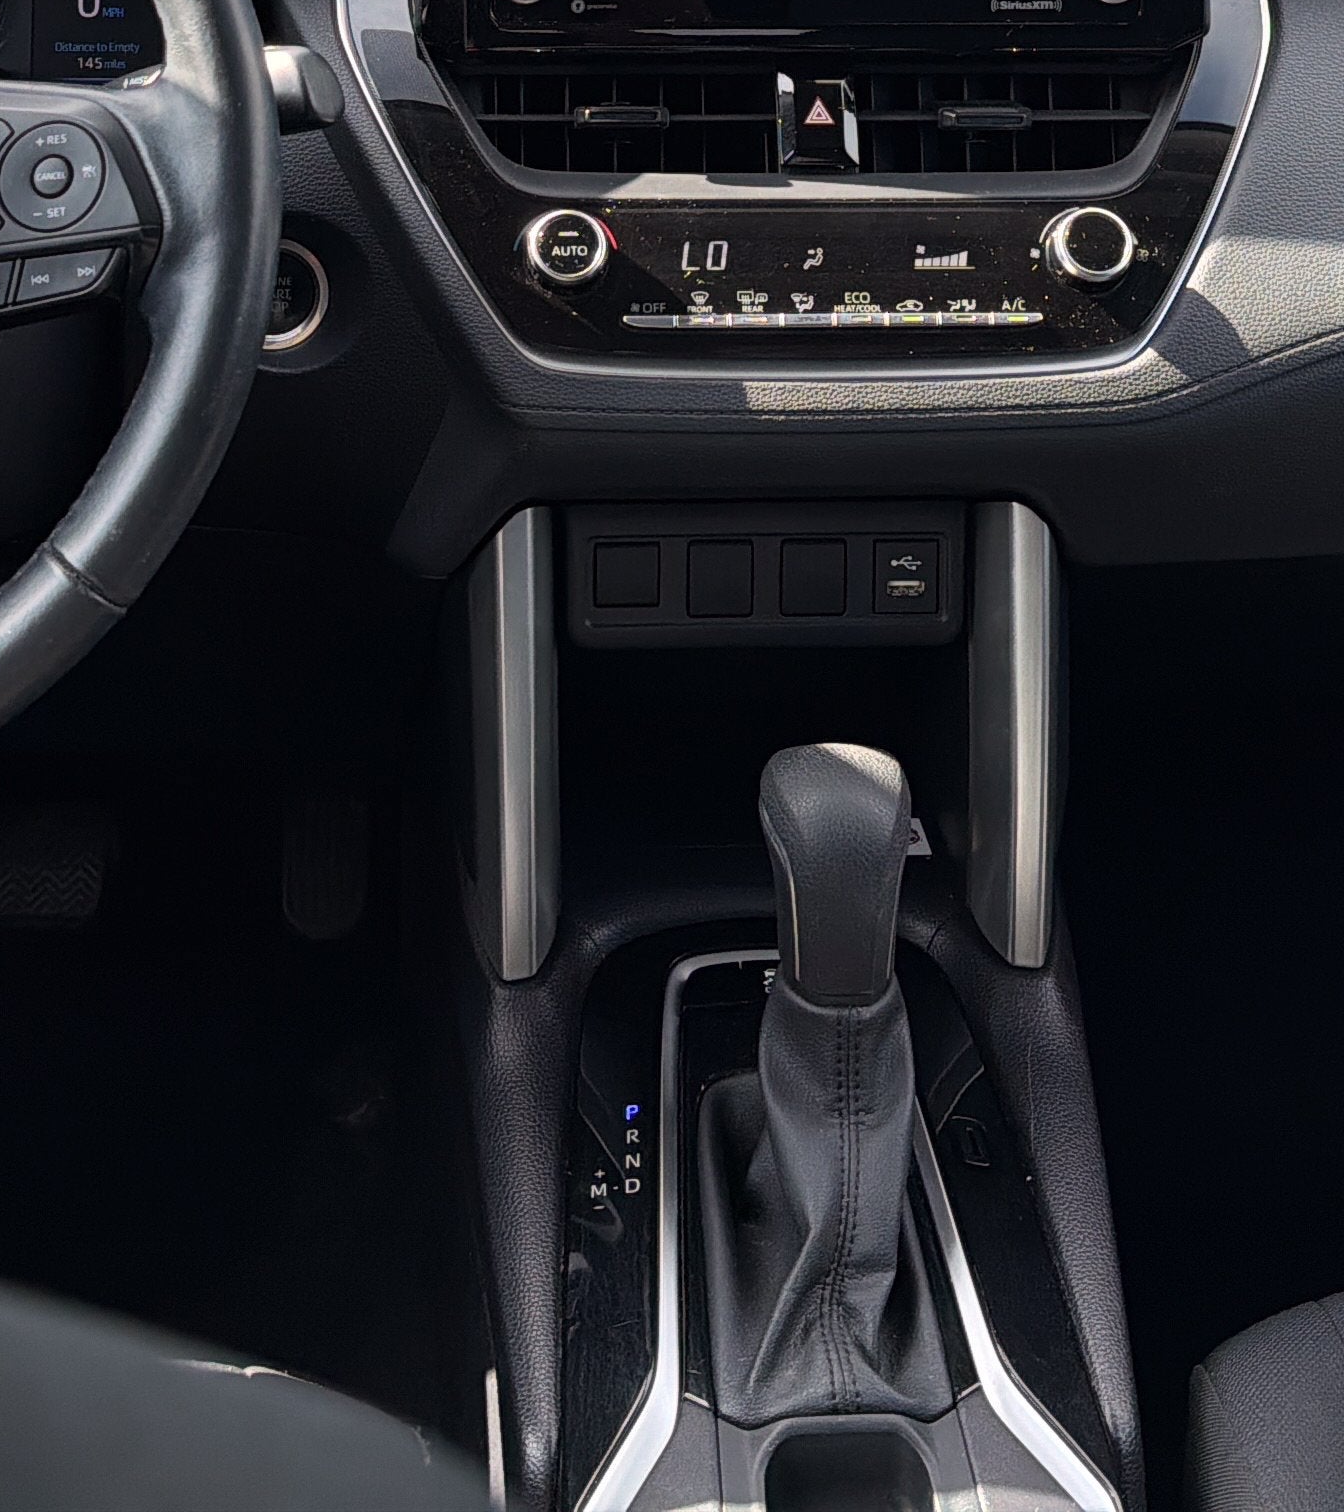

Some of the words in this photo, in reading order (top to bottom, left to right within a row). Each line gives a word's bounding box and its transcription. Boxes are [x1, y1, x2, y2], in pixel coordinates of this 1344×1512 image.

[102, 8, 124, 18] MPH
[54, 41, 95, 52] Distance
[97, 42, 108, 52] to
[109, 42, 140, 54] Empty
[77, 57, 103, 69] 145
[104, 58, 126, 68] miles
[35, 172, 66, 182] CANCEL
[551, 245, 588, 256] AUTO
[681, 241, 728, 271] LO
[844, 292, 870, 304] ECO
[642, 303, 667, 314] OFF
[687, 306, 713, 314] FRONT
[834, 305, 881, 313] HEAT/COOL
[1002, 299, 1026, 312] A/C
[626, 1104, 639, 1121] P
[626, 1129, 640, 1144] R
[625, 1153, 640, 1169] N
[591, 1183, 607, 1198] M
[625, 1179, 640, 1194] D
